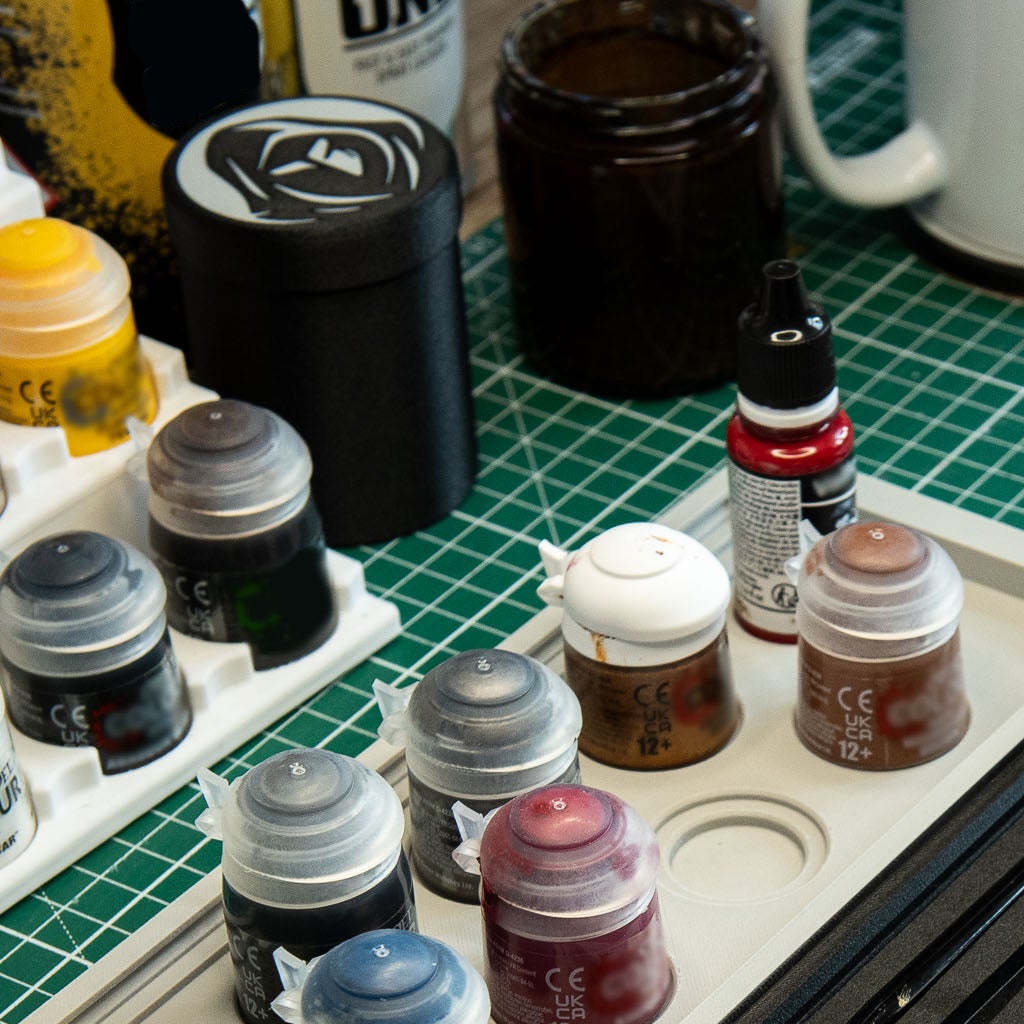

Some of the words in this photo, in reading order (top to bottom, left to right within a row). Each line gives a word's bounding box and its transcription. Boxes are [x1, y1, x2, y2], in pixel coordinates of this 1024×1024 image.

[19, 380, 57, 405] CE
[175, 576, 211, 606] CE
[634, 681, 669, 707] CE
[837, 686, 873, 714] CE
[50, 704, 91, 729] CE
[845, 714, 871, 728] UK
[61, 730, 88, 744] UK
[845, 728, 872, 741] CA
[638, 737, 671, 756] 12+
[838, 740, 872, 761] 12+
[233, 935, 261, 971] CE
[545, 967, 586, 993] CE
[555, 994, 584, 1007] UK
[556, 1008, 585, 1020] CA
